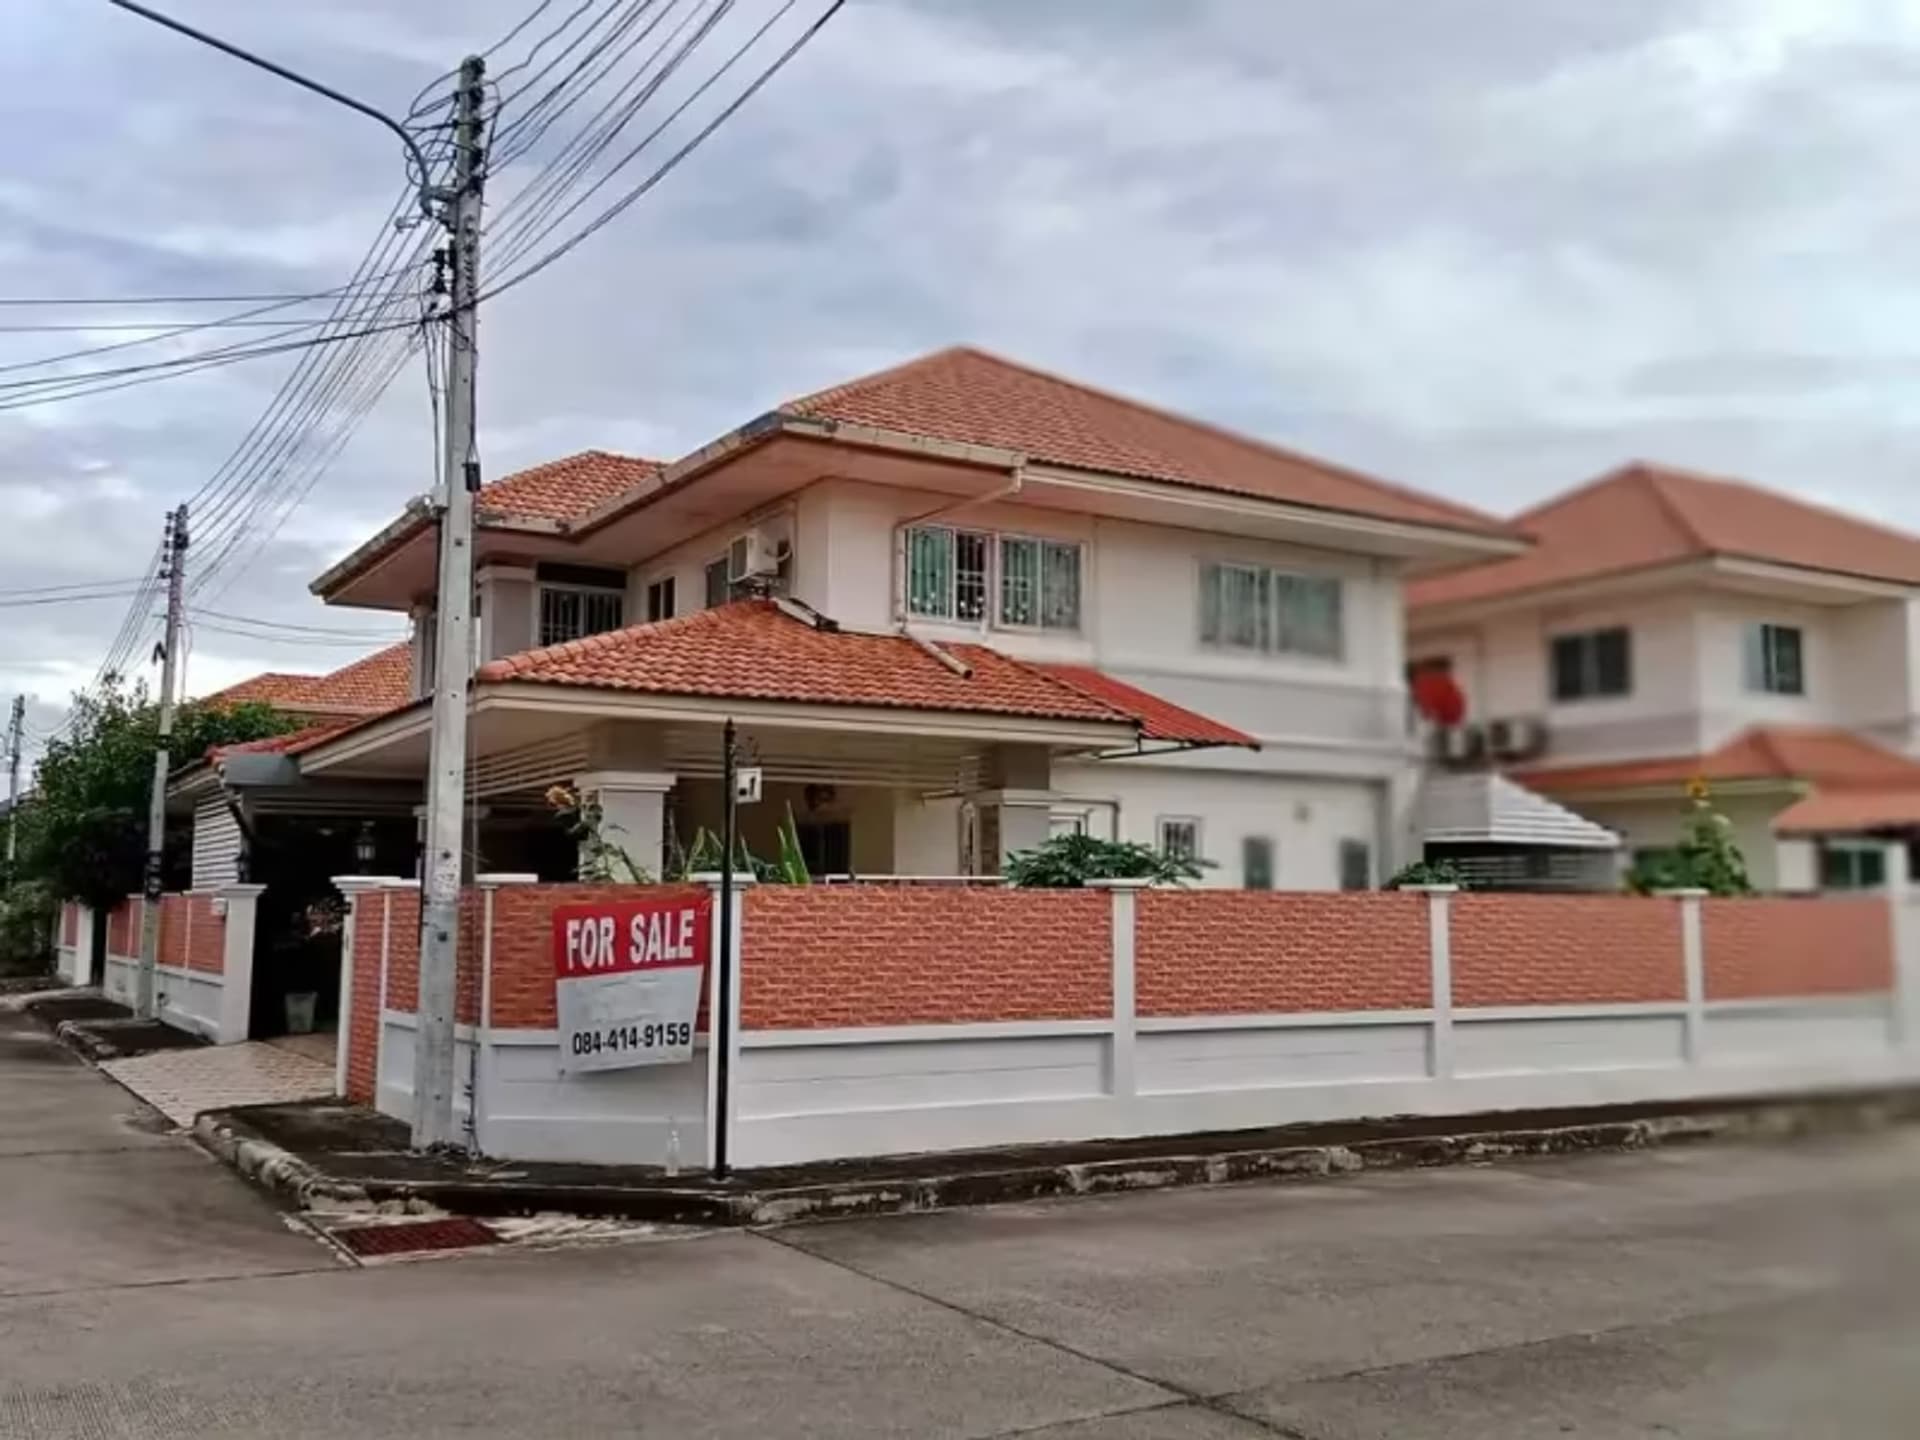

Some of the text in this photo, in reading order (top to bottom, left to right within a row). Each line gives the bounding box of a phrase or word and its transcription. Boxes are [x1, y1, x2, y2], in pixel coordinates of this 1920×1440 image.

[566, 909, 696, 970] FOR SALE
[572, 1022, 691, 1055] 084-414-9159
